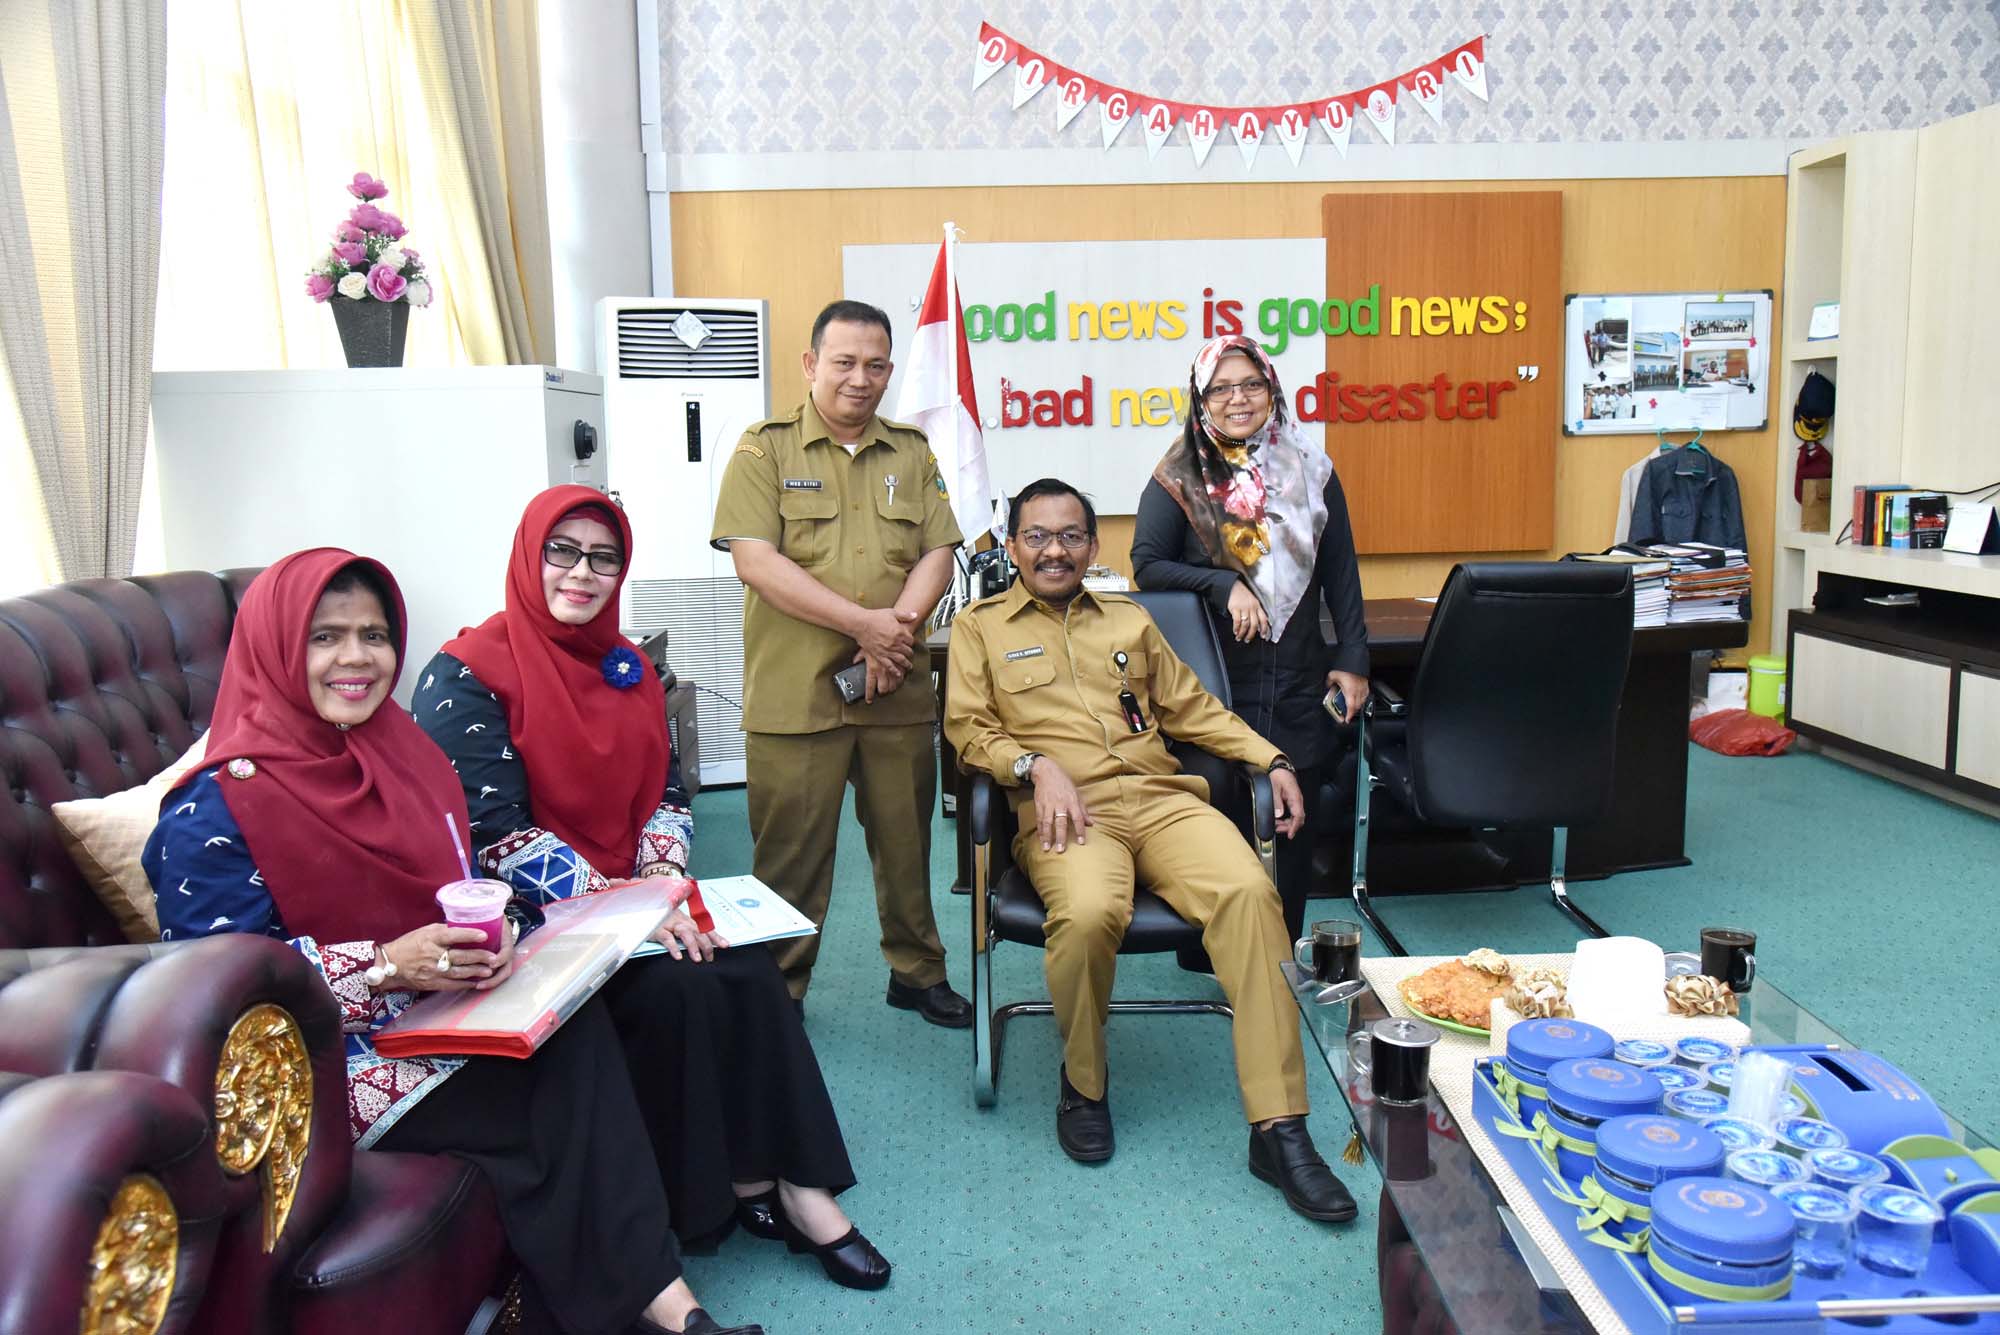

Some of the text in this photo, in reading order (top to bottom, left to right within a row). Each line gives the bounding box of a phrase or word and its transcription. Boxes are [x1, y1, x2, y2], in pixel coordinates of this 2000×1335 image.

[983, 39, 1474, 140] DIRGAHAYU RI
[1068, 300, 1187, 341] news
[1203, 287, 1243, 338] is
[1259, 284, 1381, 356] good
[1391, 296, 1528, 337] news;
[1110, 386, 1190, 428] new
